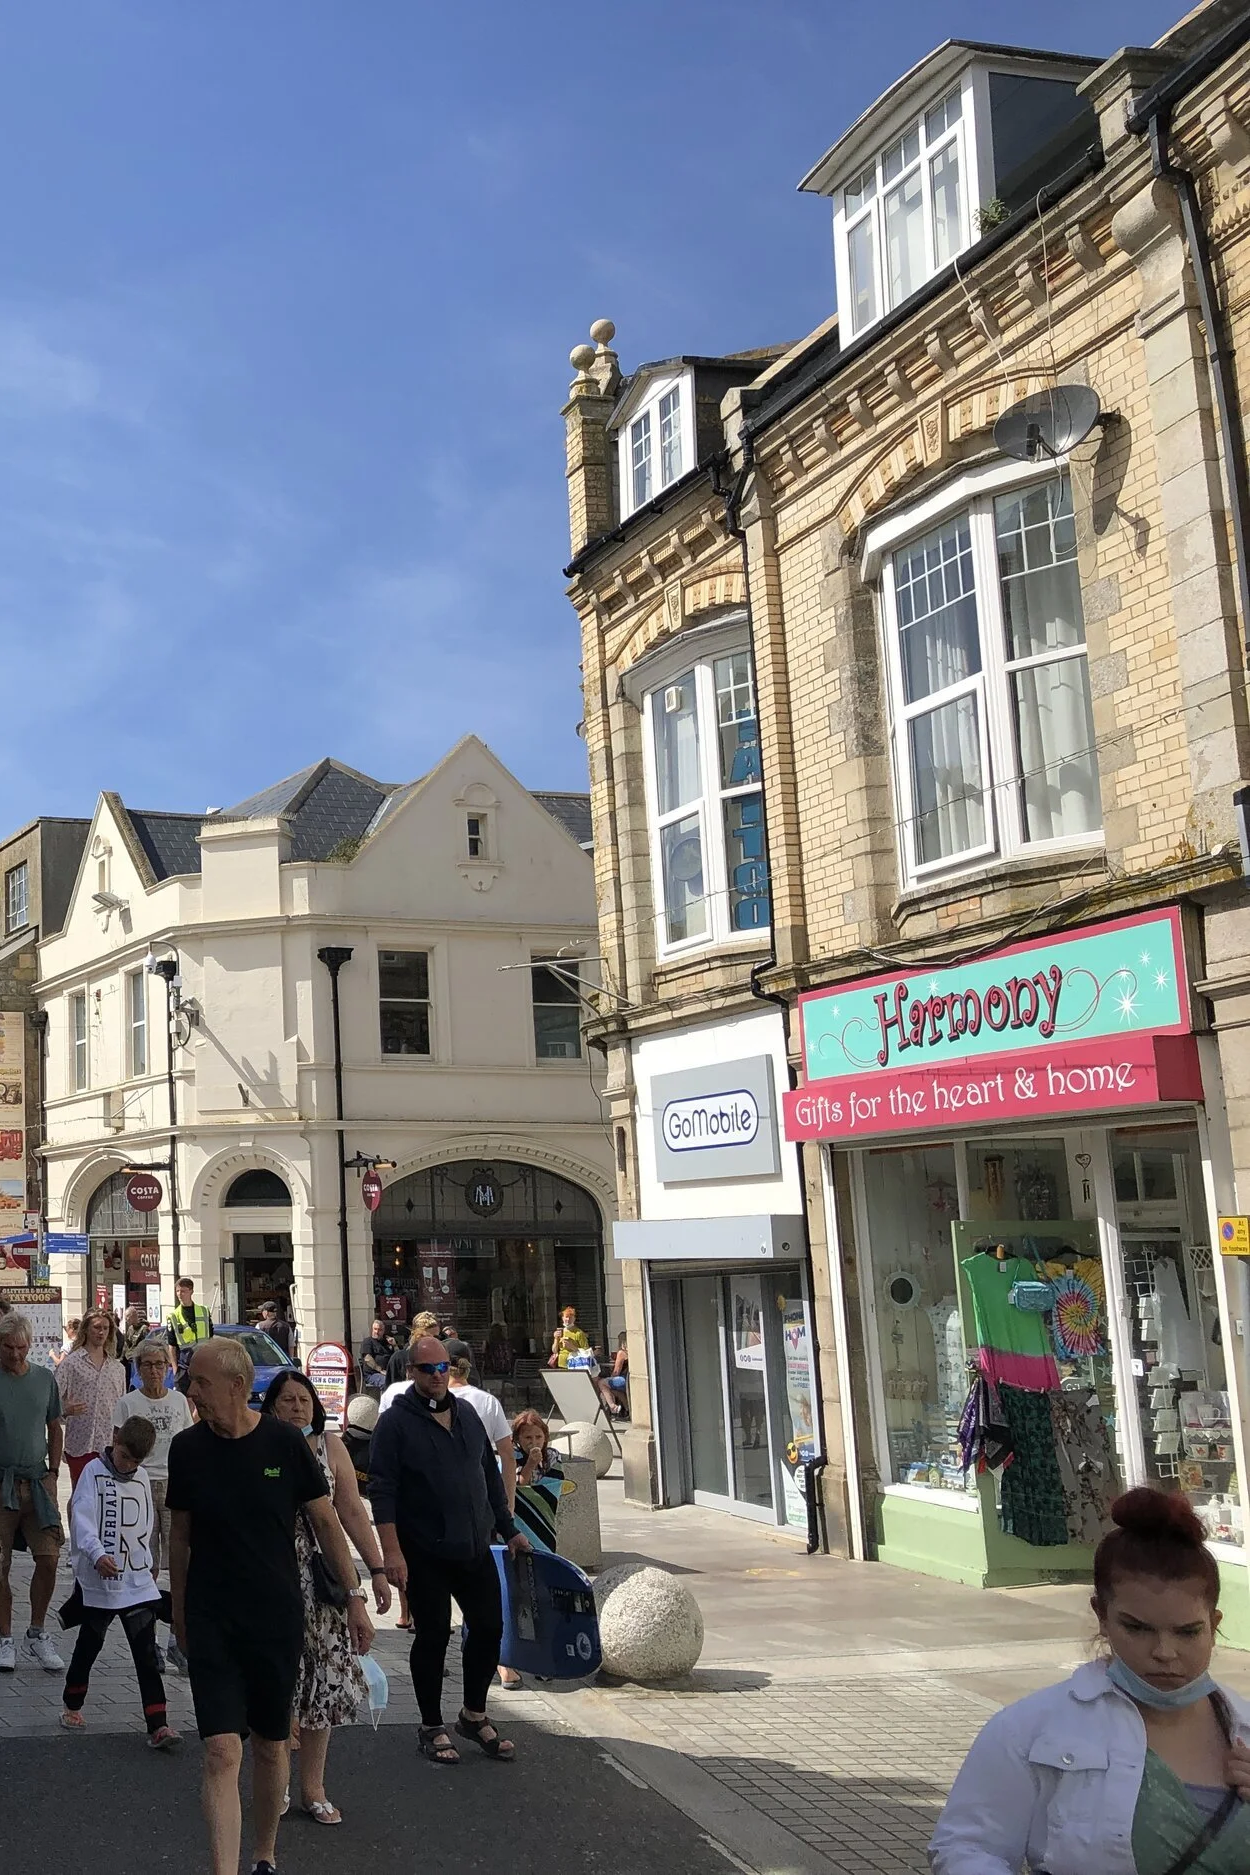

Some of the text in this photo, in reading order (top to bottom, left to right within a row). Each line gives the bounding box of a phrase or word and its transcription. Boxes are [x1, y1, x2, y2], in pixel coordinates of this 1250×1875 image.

[874, 964, 1063, 1067] Harmony
[795, 1062, 1136, 1131] Gifts for the heart & home
[669, 1102, 751, 1139] GoMobile
[131, 1187, 159, 1195] COSTA
[363, 1183, 379, 1192] COSTA
[8, 1293, 51, 1302] TATTOOS
[103, 1481, 116, 1556] IVERDALE
